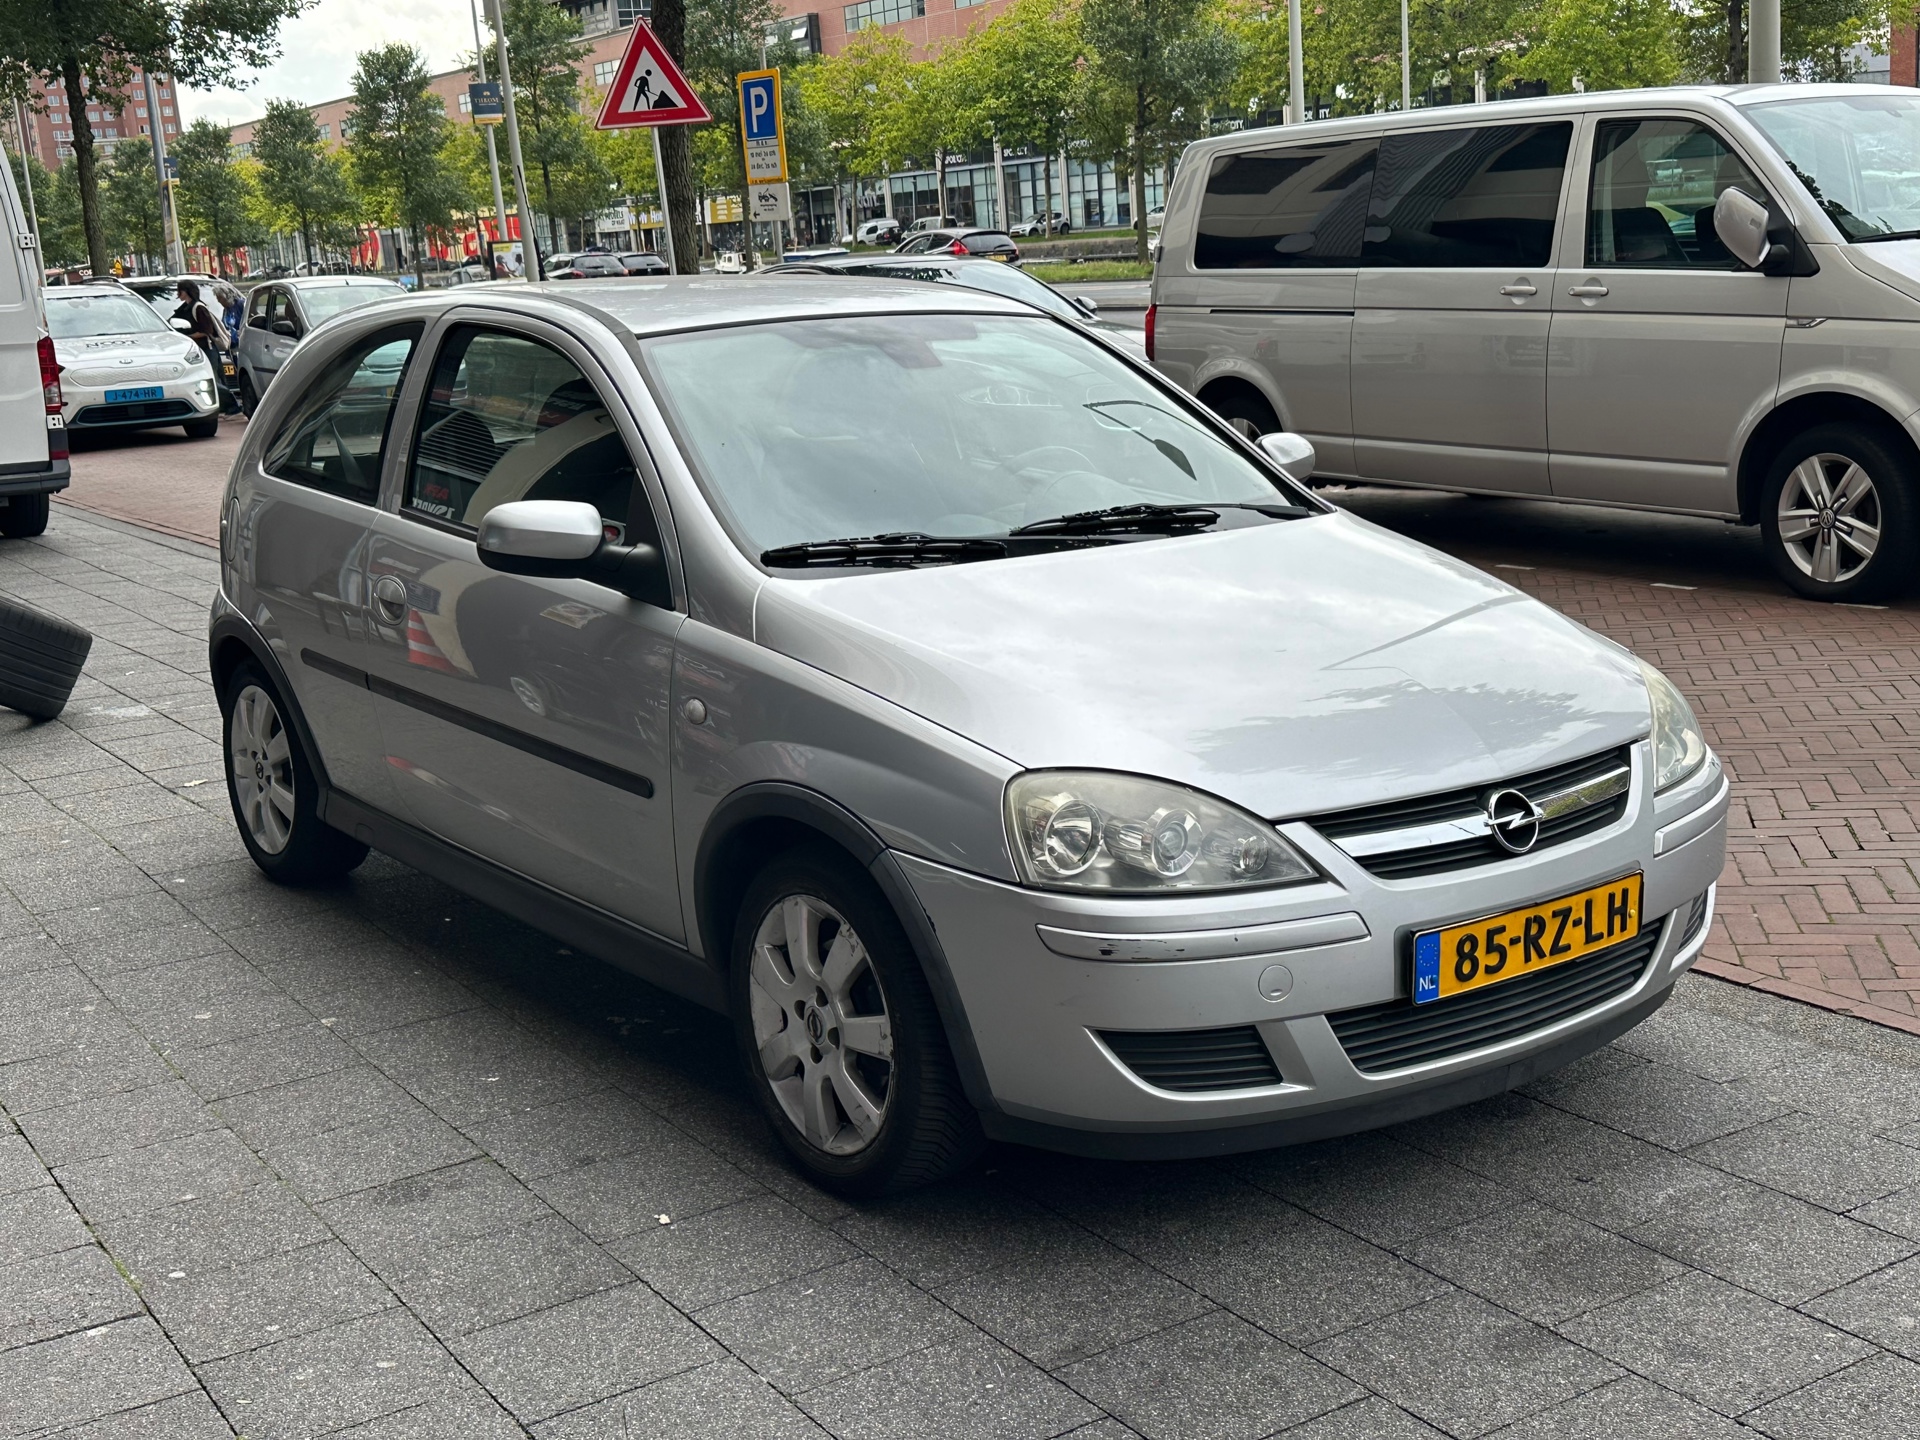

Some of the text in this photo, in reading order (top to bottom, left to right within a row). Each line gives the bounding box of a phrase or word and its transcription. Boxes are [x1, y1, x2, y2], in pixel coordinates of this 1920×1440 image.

[749, 86, 768, 133] P
[113, 388, 157, 401] J-474-HR
[1454, 887, 1629, 983] 85-RZ-LH
[1418, 974, 1437, 992] NL
